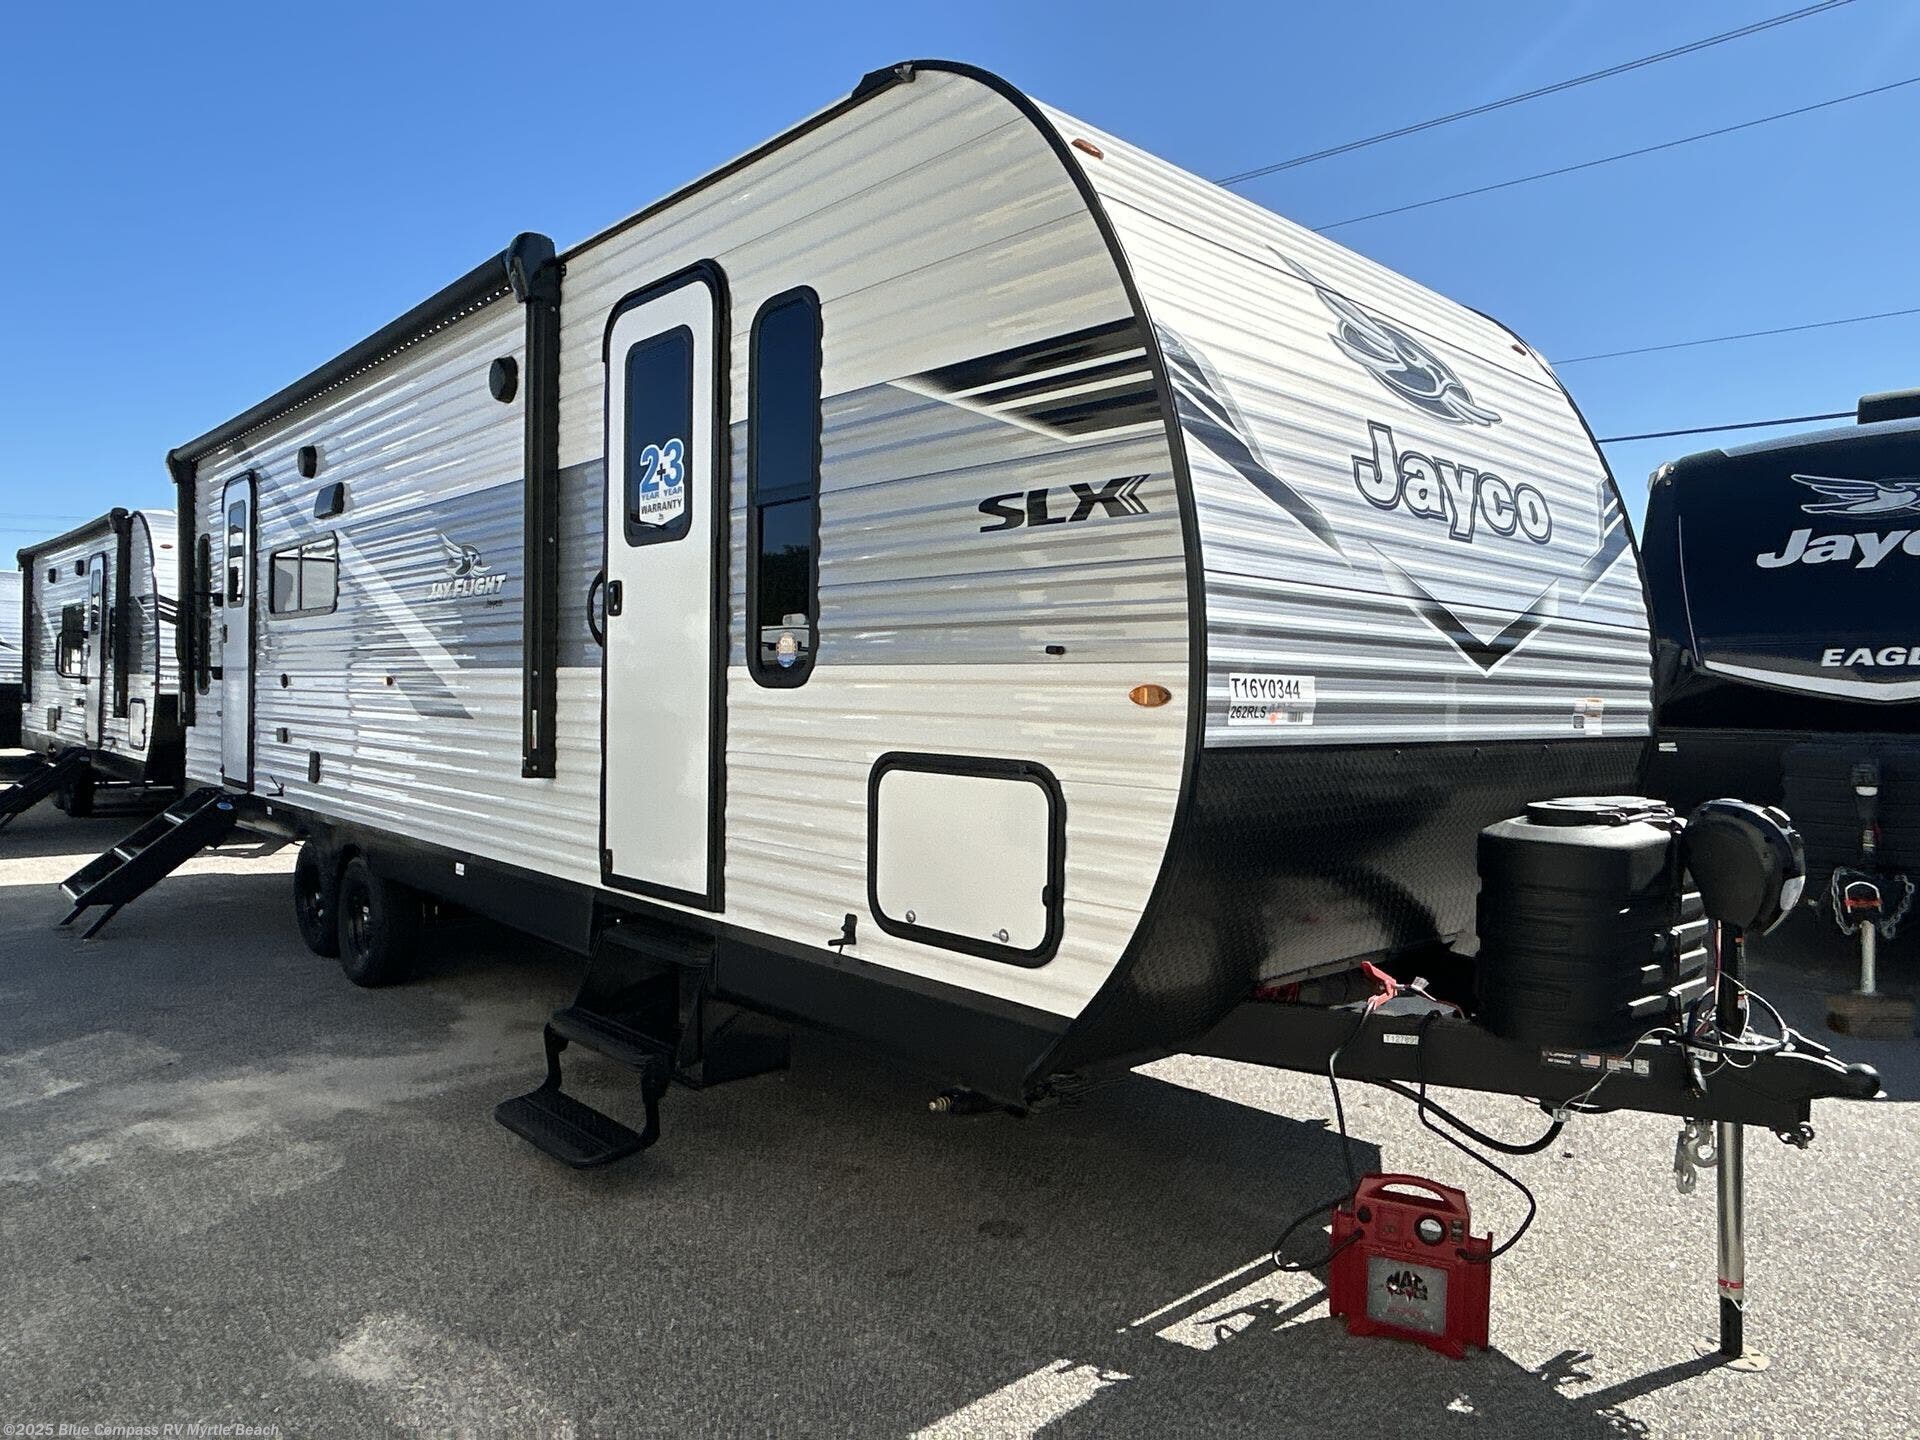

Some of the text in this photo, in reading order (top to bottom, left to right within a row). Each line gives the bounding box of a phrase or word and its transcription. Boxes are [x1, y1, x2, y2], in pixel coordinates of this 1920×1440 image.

[1351, 419, 1552, 545] Jayco
[641, 486, 682, 501] YEAR YEAR
[978, 473, 1151, 533] SLX
[641, 499, 682, 514] WARRANTY
[427, 574, 507, 602] JAY FLIGHT
[1231, 678, 1301, 699] T16Y0344
[1230, 705, 1267, 719] 262RLS
